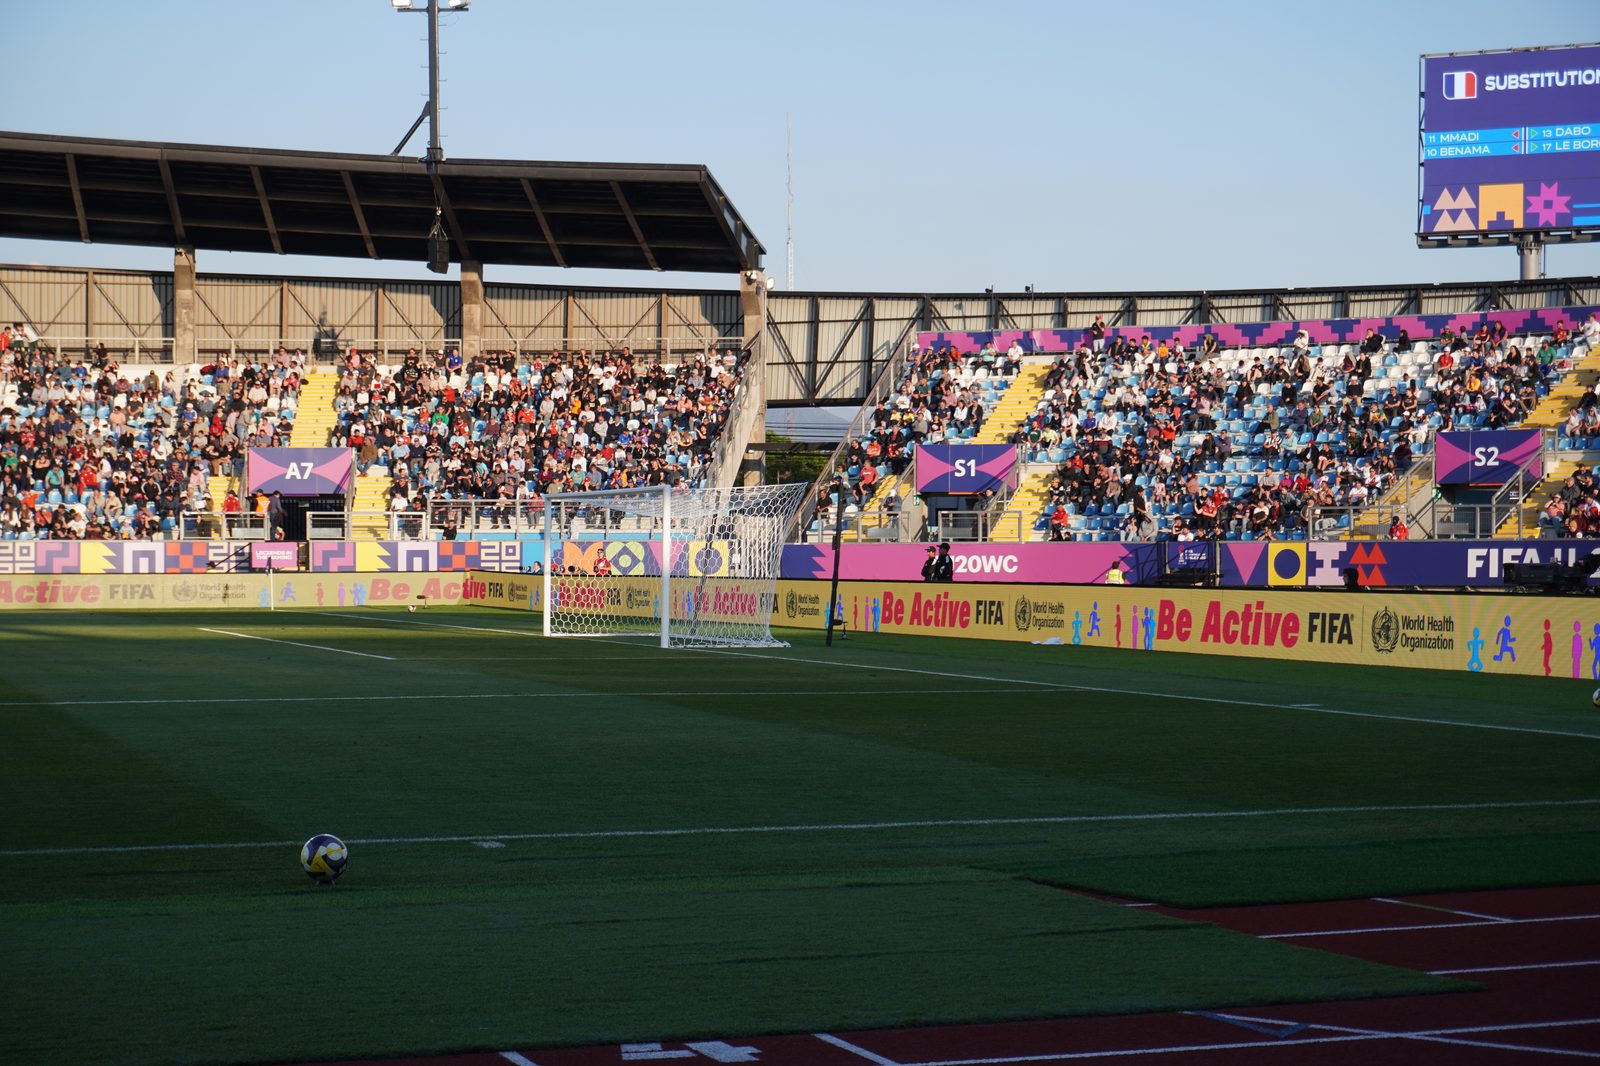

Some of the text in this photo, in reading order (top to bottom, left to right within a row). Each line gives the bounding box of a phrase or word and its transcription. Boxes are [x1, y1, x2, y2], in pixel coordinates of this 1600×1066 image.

[1428, 132, 1479, 143] 11 MMADI
[1542, 126, 1591, 137] 13 DABO
[1427, 145, 1490, 156] 10 BENAMA
[1542, 139, 1600, 151] 17 LE BOR
[1474, 446, 1500, 467] S2
[285, 462, 314, 480] A7
[954, 459, 976, 477] S1
[932, 554, 1018, 574] 20WC
[0, 579, 155, 603] Active FIFA
[368, 578, 410, 600] Be
[421, 575, 487, 600] Active
[488, 582, 504, 598] FIFA
[881, 591, 1003, 629] Be Active FIFA
[1032, 601, 1065, 616] World Health
[1032, 615, 1065, 630] Organization
[1156, 599, 1353, 649] Be Active FIFA
[1401, 615, 1454, 633] World Health
[1401, 633, 1454, 652] Organization
